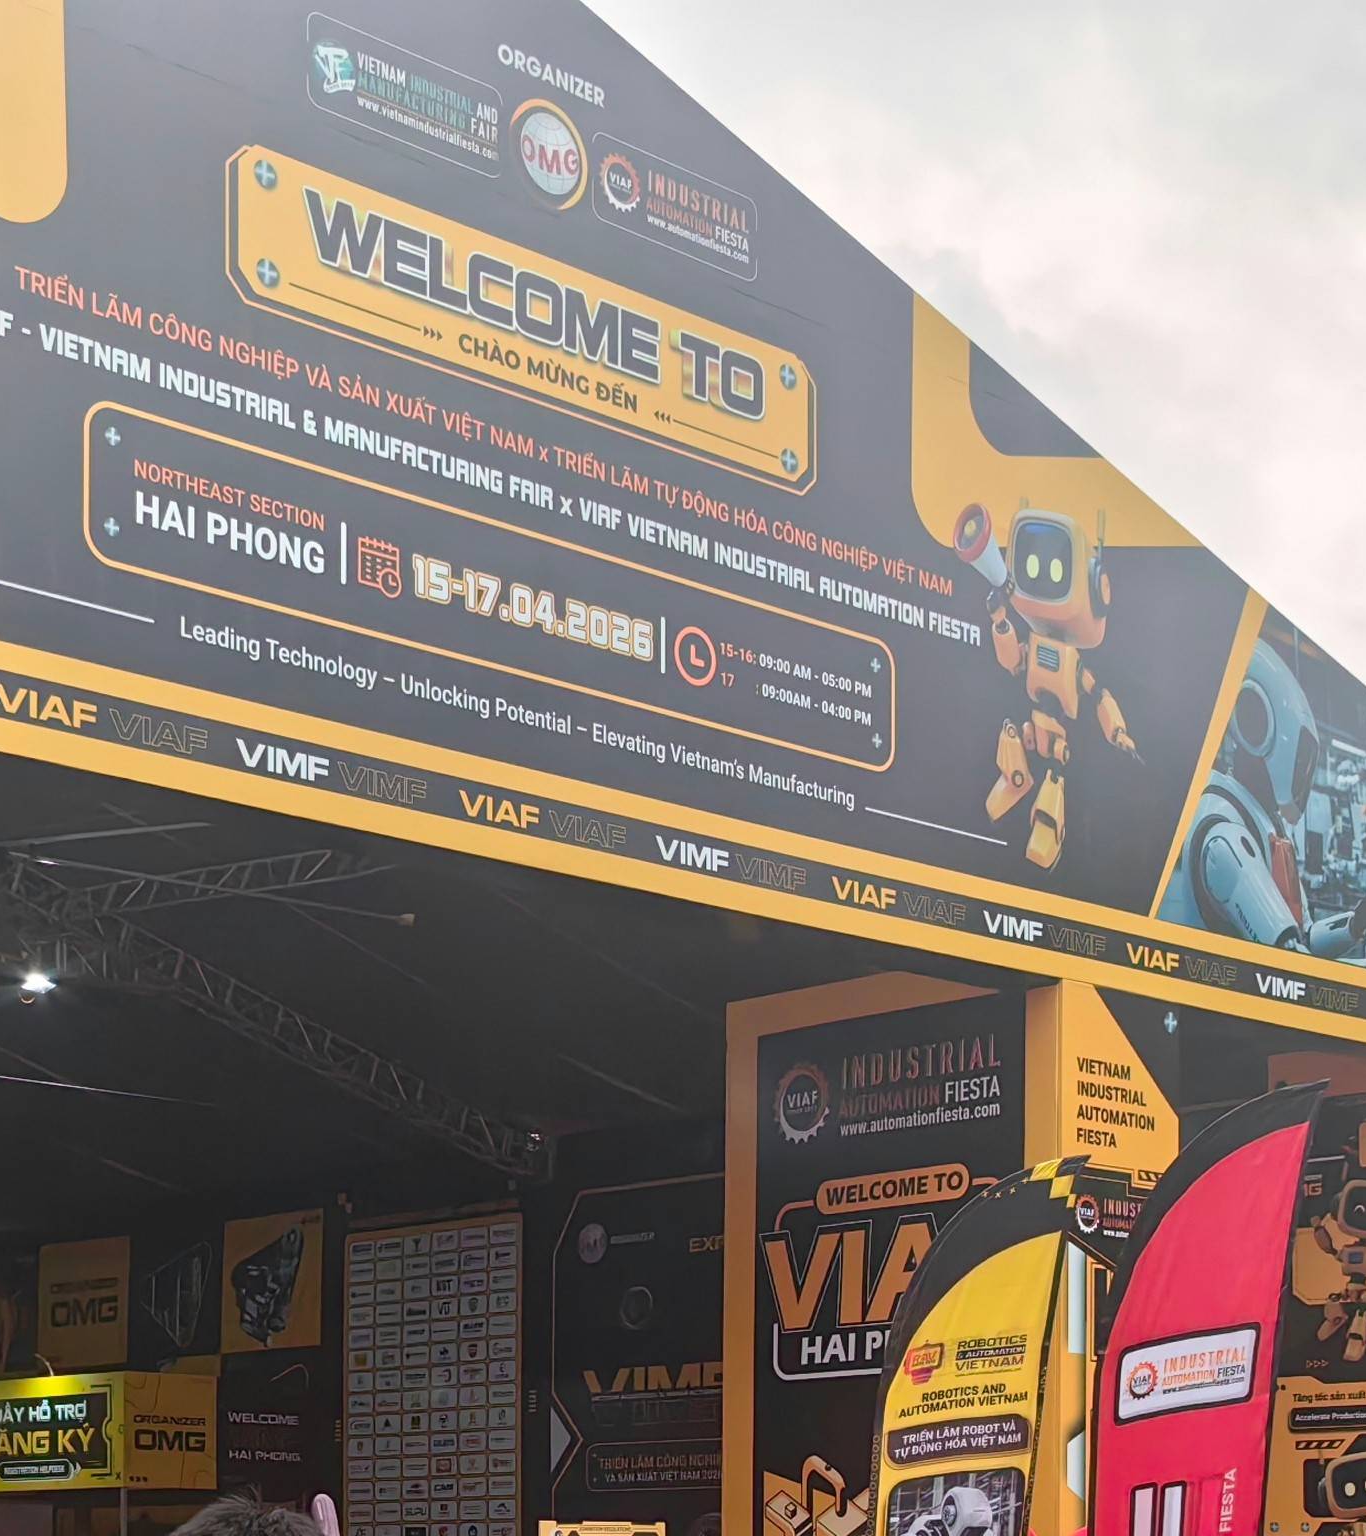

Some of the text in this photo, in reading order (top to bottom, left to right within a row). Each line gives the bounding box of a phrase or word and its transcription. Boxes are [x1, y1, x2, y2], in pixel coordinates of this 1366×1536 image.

[357, 52, 498, 125] VIETNAM AND
[497, 44, 606, 108] ORGANIZER
[470, 116, 499, 143] FAIR
[522, 135, 580, 177] OMG
[647, 169, 750, 234] INDUSTRIAL
[714, 226, 750, 253] FIESTA
[303, 185, 764, 420] WELCOME TO
[458, 332, 638, 413] CHÀO MỪNG ĐẾN
[14, 265, 953, 597] TRIỂN LÃM CÔNG NGHIỆP VÀ SẢN XUẤT VIỆT NAM TRIỂN LÃM TỰ ĐỘNG HÓA CÔNG NGHIỆP VIỆT NAM
[39, 323, 151, 383] VIETNAM
[159, 361, 295, 429] INDUSTRIAL
[303, 410, 317, 437] &
[324, 417, 503, 494] MANUFACTURING
[509, 475, 553, 511] FAIR
[579, 497, 622, 531] VIAF
[628, 513, 708, 561] VIETNAM
[714, 541, 814, 593] INDUSTRIAL
[819, 575, 923, 628] AUTOMATION
[928, 610, 981, 646] FIESTA
[134, 458, 325, 531] NORTHEAST SECTION
[135, 491, 324, 574] HAI PHONG
[412, 552, 654, 660] 15-17.04.2026
[759, 653, 791, 674] 09:00
[793, 663, 812, 681] AM
[821, 671, 852, 692] 05:00
[854, 681, 872, 698] PM
[179, 615, 856, 811] Leading Technology Unlocking Potential Elevating Vietnam's Manufacturing
[235, 737, 331, 782] VIMF
[458, 789, 541, 829] VIAF
[655, 835, 730, 873] VIMF
[831, 875, 897, 910] VIAF
[983, 911, 1044, 942] VIMF
[1126, 942, 1180, 972] VIAF
[1256, 973, 1307, 1001] VIMF
[842, 1033, 1001, 1089] INDUSTRIAL
[1077, 1056, 1131, 1081] VIETNAM
[944, 1075, 1001, 1103] FIESTA
[1077, 1080, 1146, 1107] INDUSTRIAL
[840, 1102, 1001, 1136] www.automationfiesta.com
[1076, 1127, 1117, 1148] FIESTA
[1077, 1105, 1155, 1131] AUTOMATION
[826, 1170, 963, 1207] WELCOME TO
[899, 1391, 1028, 1418] AUTOMATION VIETNAM
[922, 1384, 1006, 1402] ROBOTICS AND
[58, 1423, 94, 1452] KÝ
[134, 1428, 206, 1453] OMG
